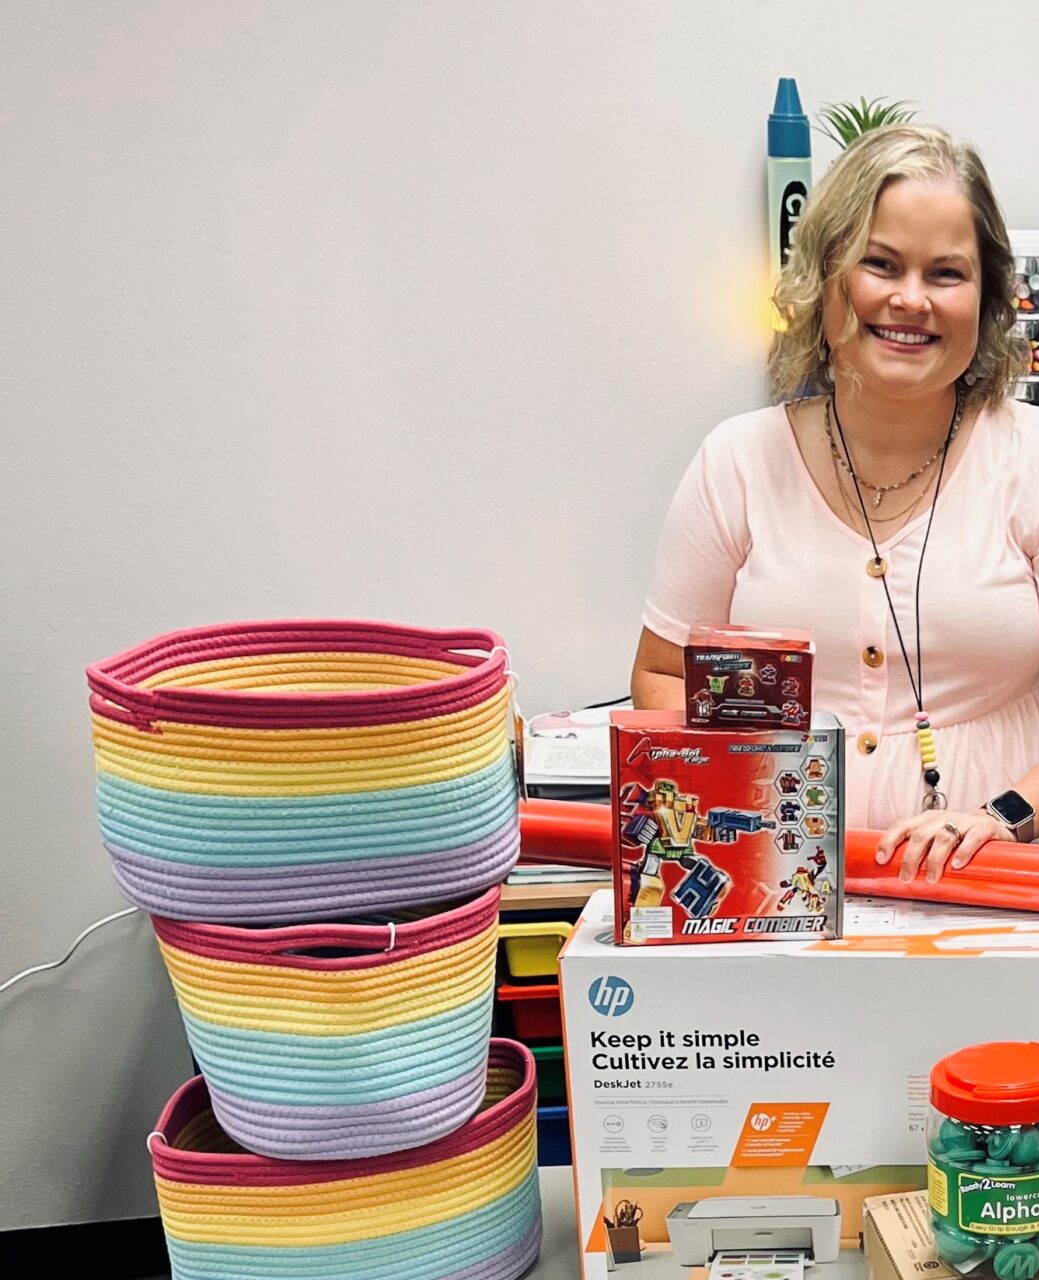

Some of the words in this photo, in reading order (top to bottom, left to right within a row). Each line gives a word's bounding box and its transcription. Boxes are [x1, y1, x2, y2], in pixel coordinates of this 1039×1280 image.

[682, 917, 740, 935] MAGIC
[743, 915, 826, 933] COMBINER
[591, 976, 634, 1017] hp
[590, 1031, 652, 1051] Keep
[660, 1030, 675, 1048] it
[683, 1030, 760, 1050] simple
[592, 1053, 689, 1070] Cultivez
[696, 1052, 716, 1069] la
[723, 1051, 836, 1072] simplicité
[594, 1080, 642, 1089] DeskJet
[645, 1081, 674, 1089] 2755e
[751, 1112, 772, 1132] hp
